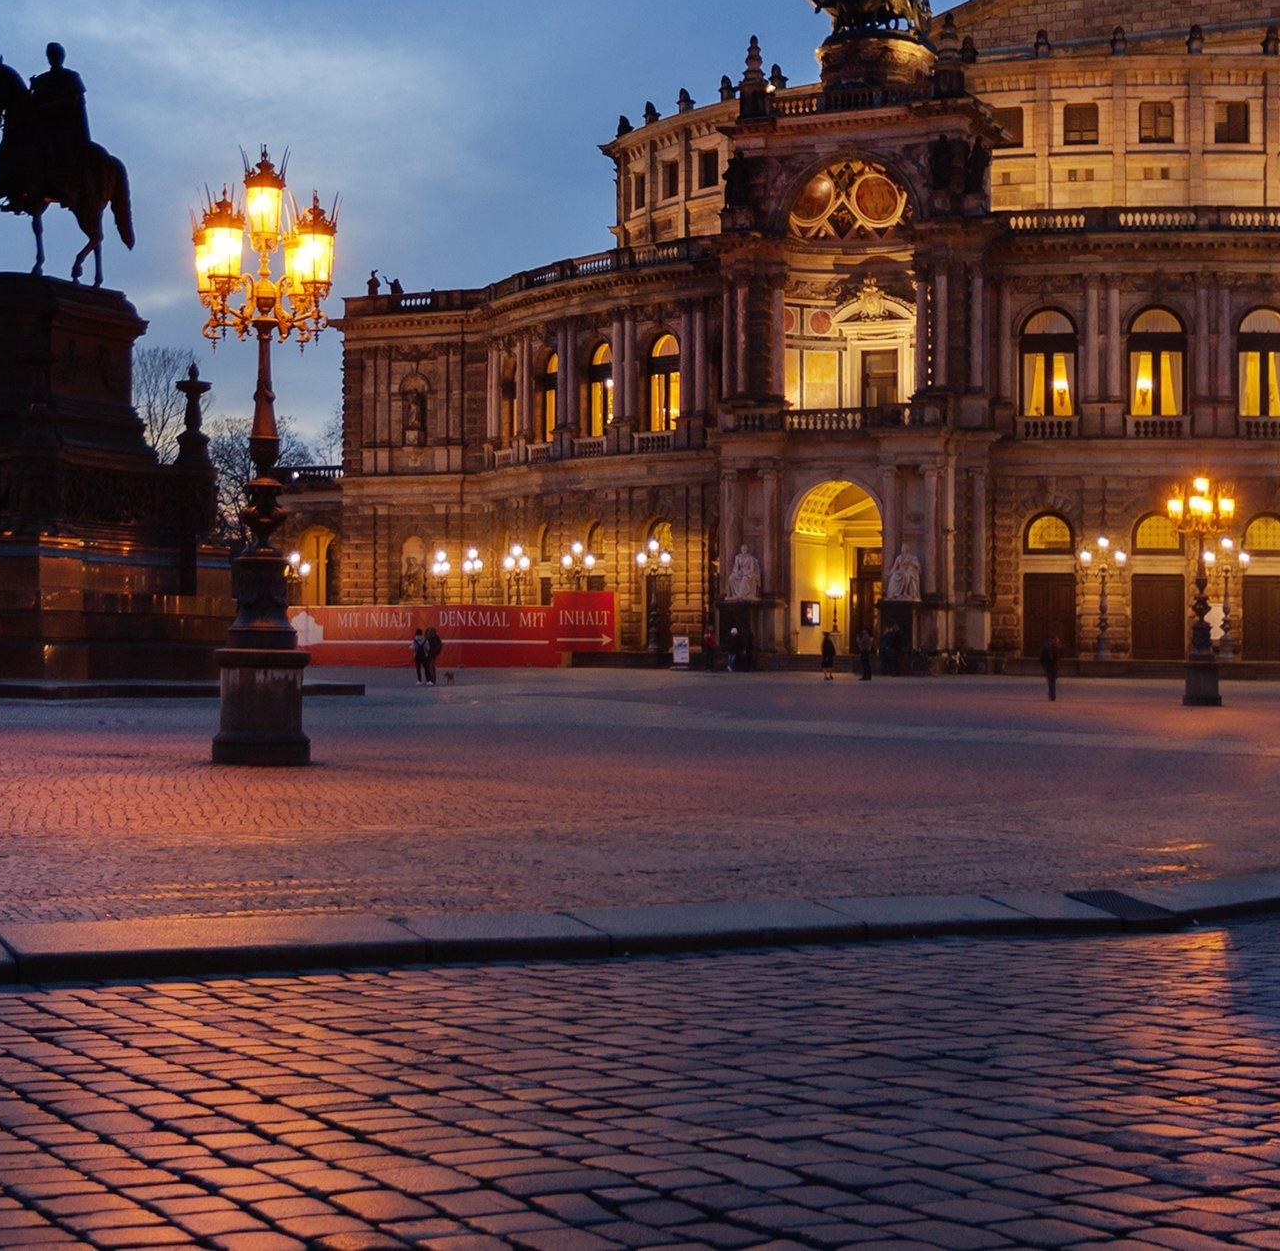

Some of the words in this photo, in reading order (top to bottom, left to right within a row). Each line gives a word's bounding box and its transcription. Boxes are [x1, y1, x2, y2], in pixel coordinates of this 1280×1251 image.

[337, 612, 360, 627] MIT
[365, 612, 414, 627] INHALT
[439, 611, 510, 628] DENKMAL
[519, 612, 547, 628] MIT
[559, 610, 612, 626] INHALT
